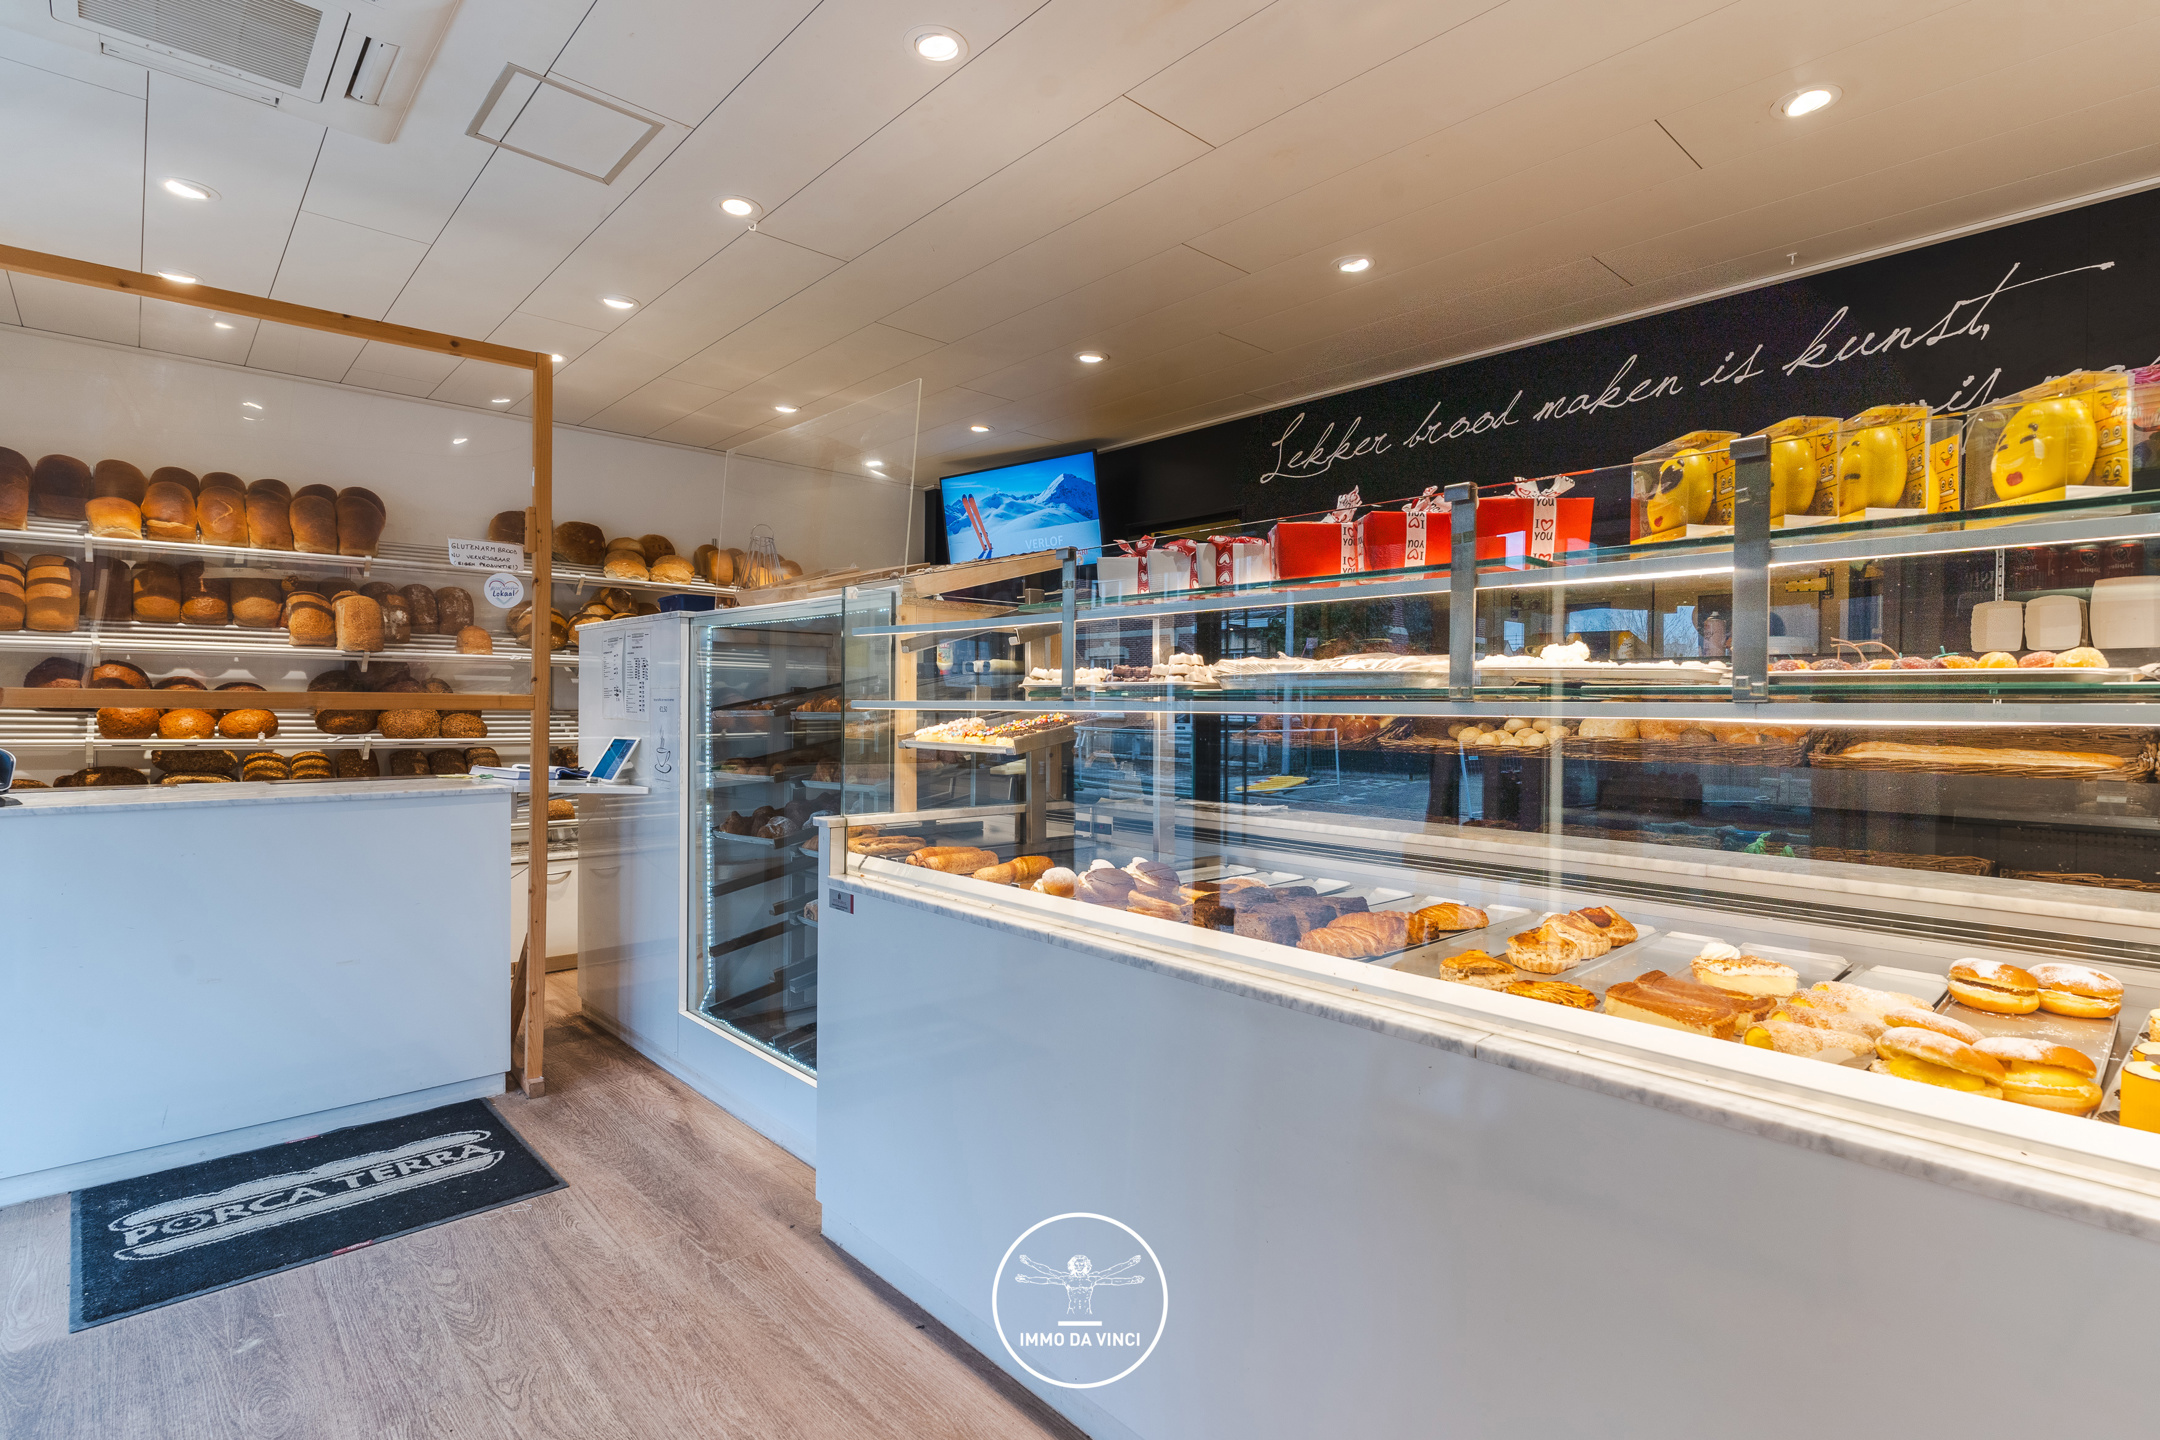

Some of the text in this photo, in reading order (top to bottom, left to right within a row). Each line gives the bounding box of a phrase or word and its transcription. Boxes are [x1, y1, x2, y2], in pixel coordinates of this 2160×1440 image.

[1259, 261, 2116, 484] Lekker brood maken is kunst,
[1024, 535, 1064, 550] VERLOF
[1534, 531, 1553, 541] YOU
[451, 542, 518, 555] GLUTENARM BROOD
[1407, 539, 1425, 549] YOU
[492, 590, 515, 598] Lokaal
[123, 1143, 492, 1248] PORCA TERRA
